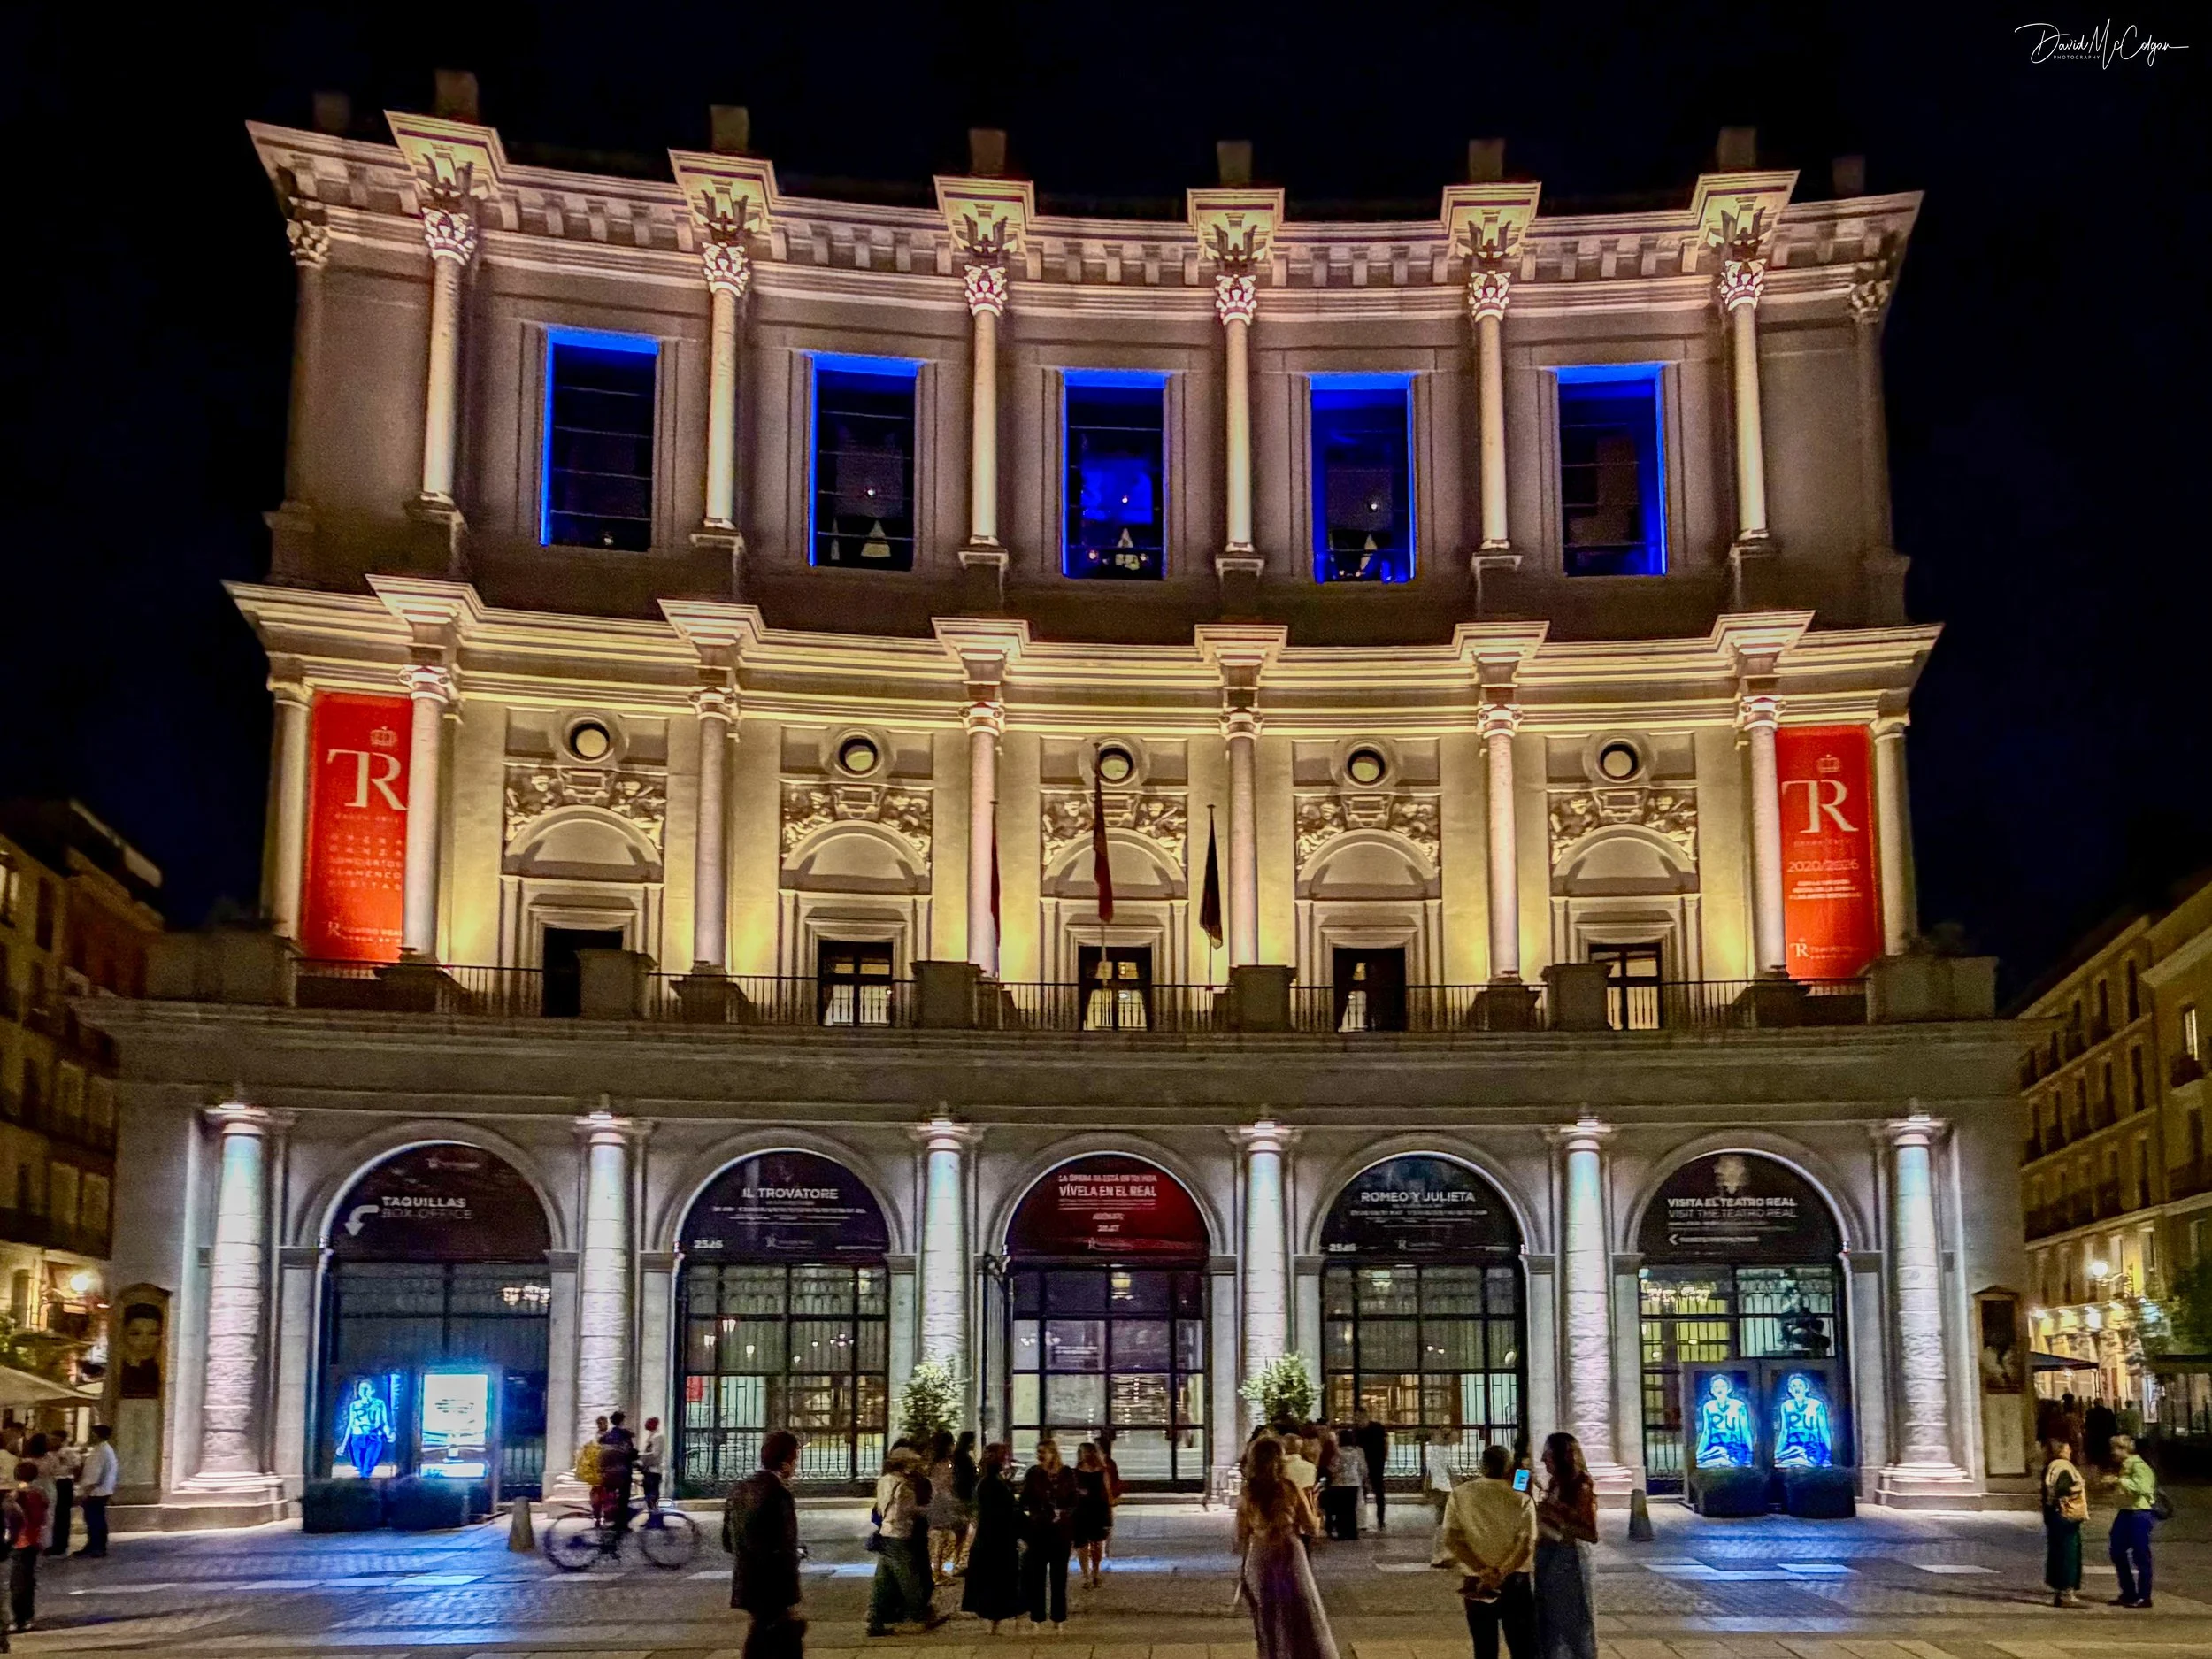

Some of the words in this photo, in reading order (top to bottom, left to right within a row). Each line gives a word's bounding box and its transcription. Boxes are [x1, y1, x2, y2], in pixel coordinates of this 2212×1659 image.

[326, 749, 407, 811] TR
[1781, 779, 1859, 833] TR
[741, 1188, 756, 1199] IL
[757, 1187, 839, 1200] TROVATORE
[1059, 1184, 1098, 1197] VÍVELA
[1099, 1186, 1113, 1197] EN
[1115, 1186, 1128, 1197] EL
[1130, 1186, 1157, 1197] REAL
[1361, 1191, 1409, 1202] ROMEO
[1409, 1191, 1421, 1203] Y
[1424, 1191, 1476, 1202] JULIETA
[381, 1195, 467, 1209] TAQUILLAS
[1667, 1197, 1703, 1208] VISITA
[1705, 1197, 1720, 1208] EL
[1720, 1197, 1765, 1208] TEATRO
[1766, 1197, 1798, 1208] REAL
[1668, 1209, 1696, 1218] VISIT
[1698, 1209, 1721, 1218] THE
[1722, 1209, 1764, 1218] TEATRO
[1765, 1209, 1797, 1218] REAL
